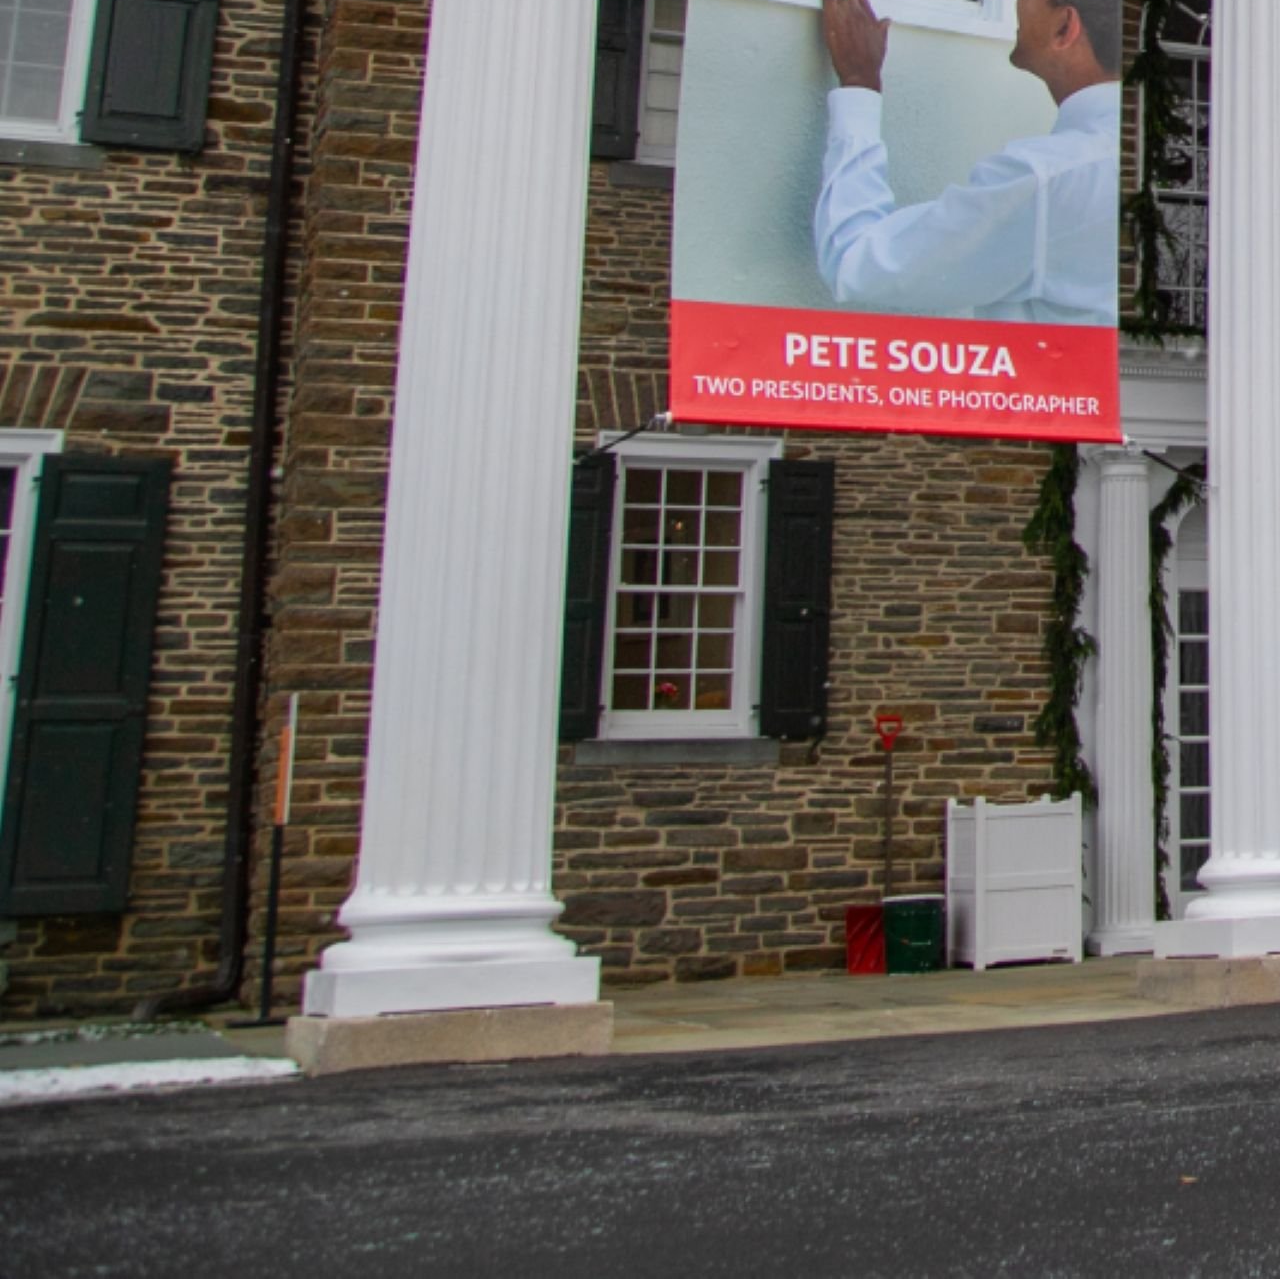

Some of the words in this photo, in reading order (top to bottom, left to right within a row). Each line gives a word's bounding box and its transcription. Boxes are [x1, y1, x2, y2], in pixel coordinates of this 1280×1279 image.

[785, 332, 877, 370] PETE
[887, 340, 1017, 378] SOUZA
[693, 375, 745, 397] TWO
[751, 381, 884, 407] PRESIDENTS,
[888, 386, 933, 409] ONE
[937, 389, 1101, 416] PHOTOGRAPHER
